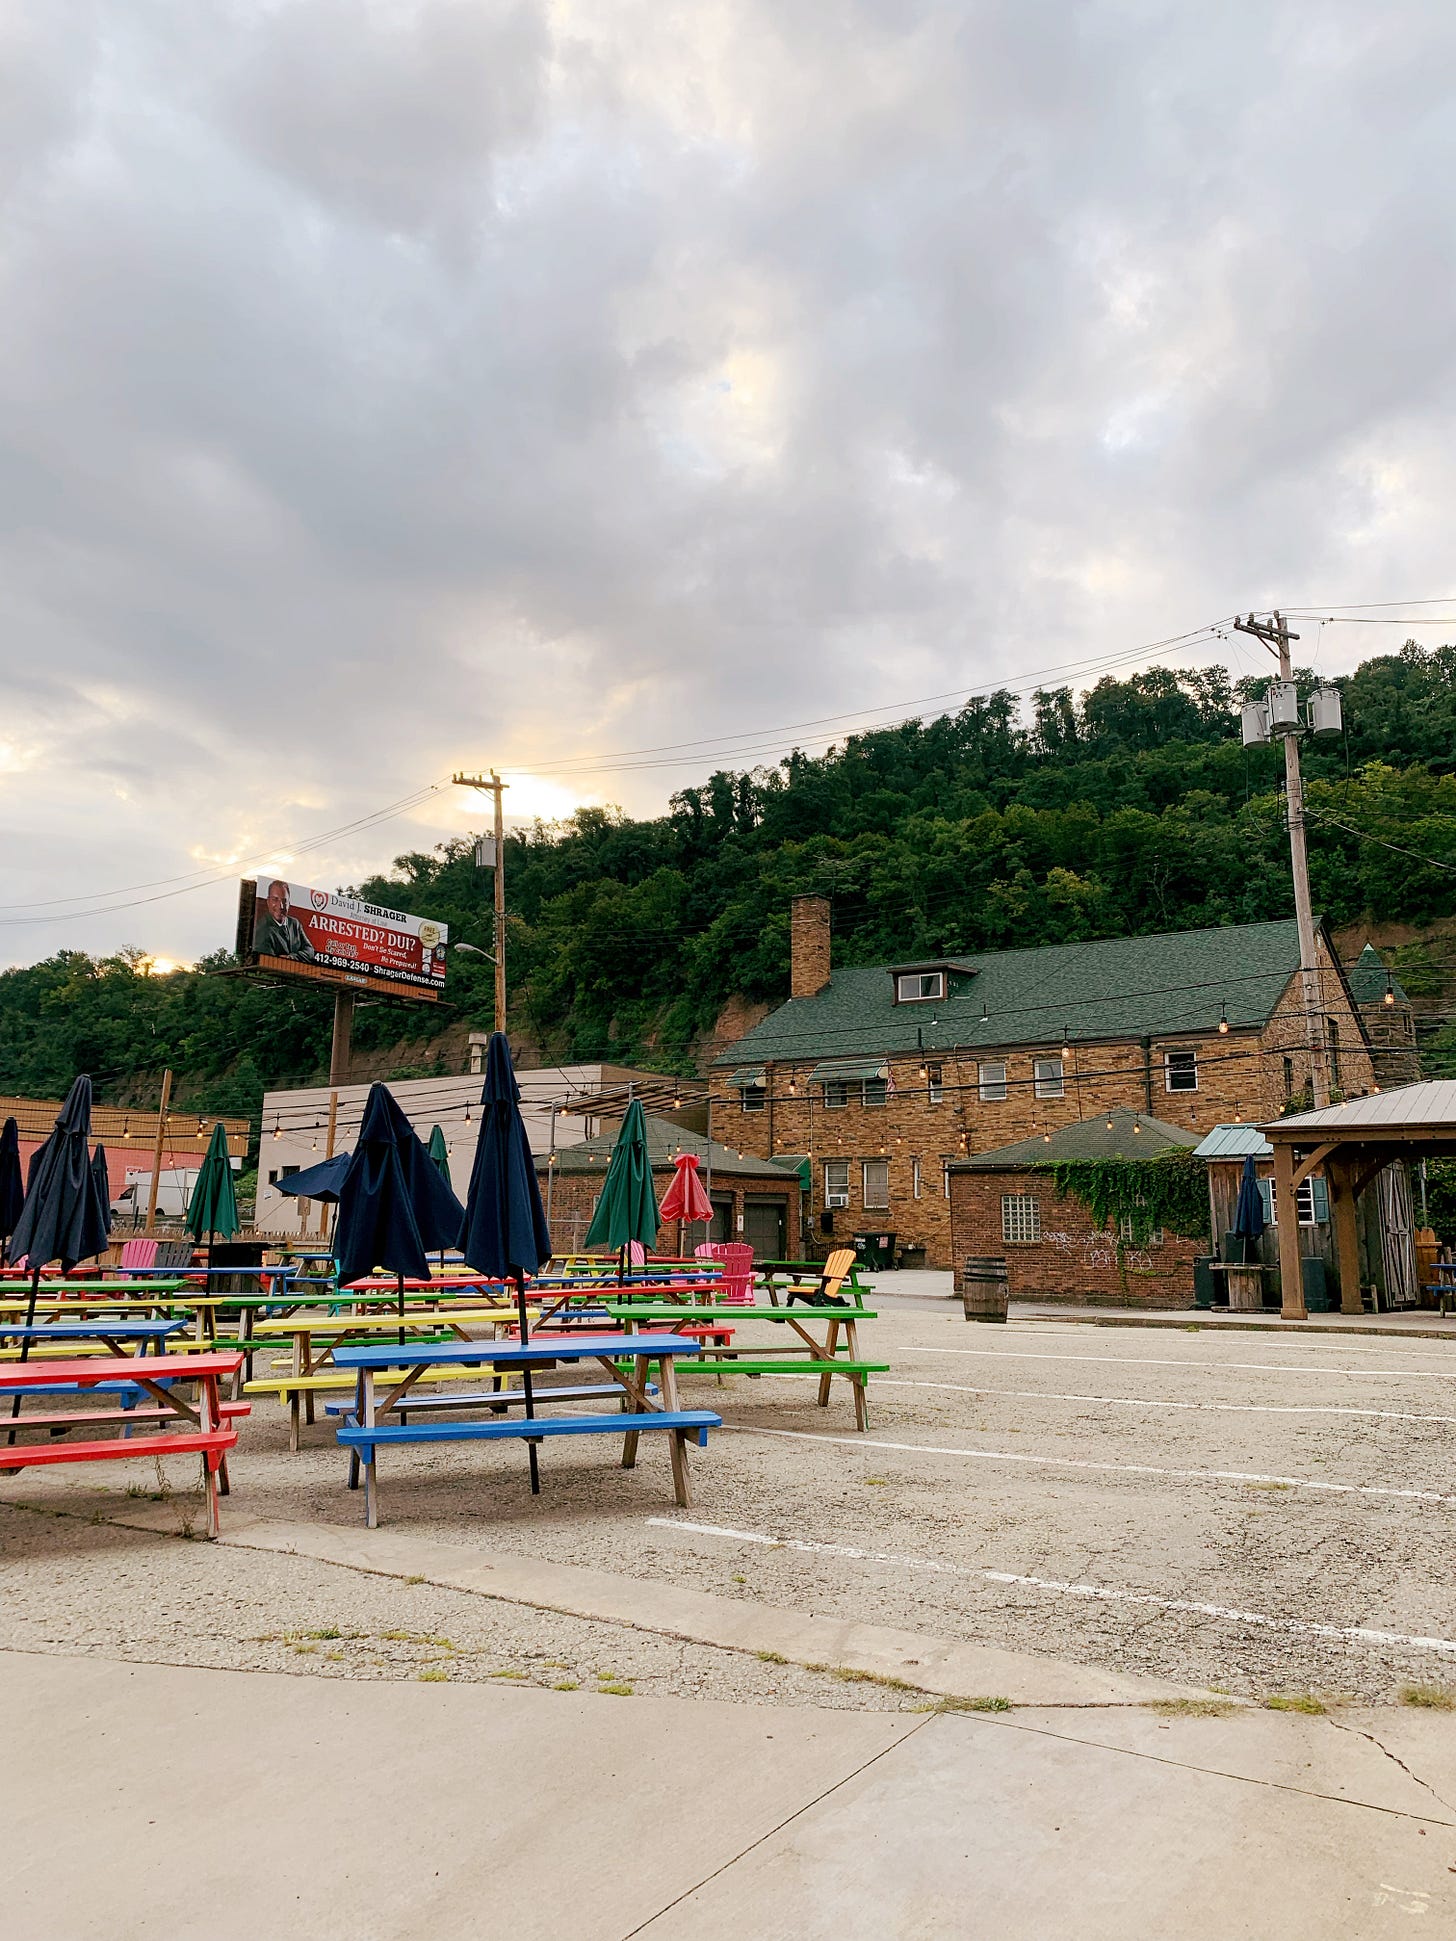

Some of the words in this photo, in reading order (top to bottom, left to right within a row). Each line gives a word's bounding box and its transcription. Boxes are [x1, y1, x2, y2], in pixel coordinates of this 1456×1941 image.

[331, 896, 355, 910] David
[364, 905, 407, 923] SHRAGER
[309, 915, 385, 944] ARRESTED?
[387, 932, 416, 952] DUI?
[363, 943, 379, 952] Don't
[314, 953, 370, 972] 412-969-2540
[373, 965, 445, 988] ShragerDefense.com
